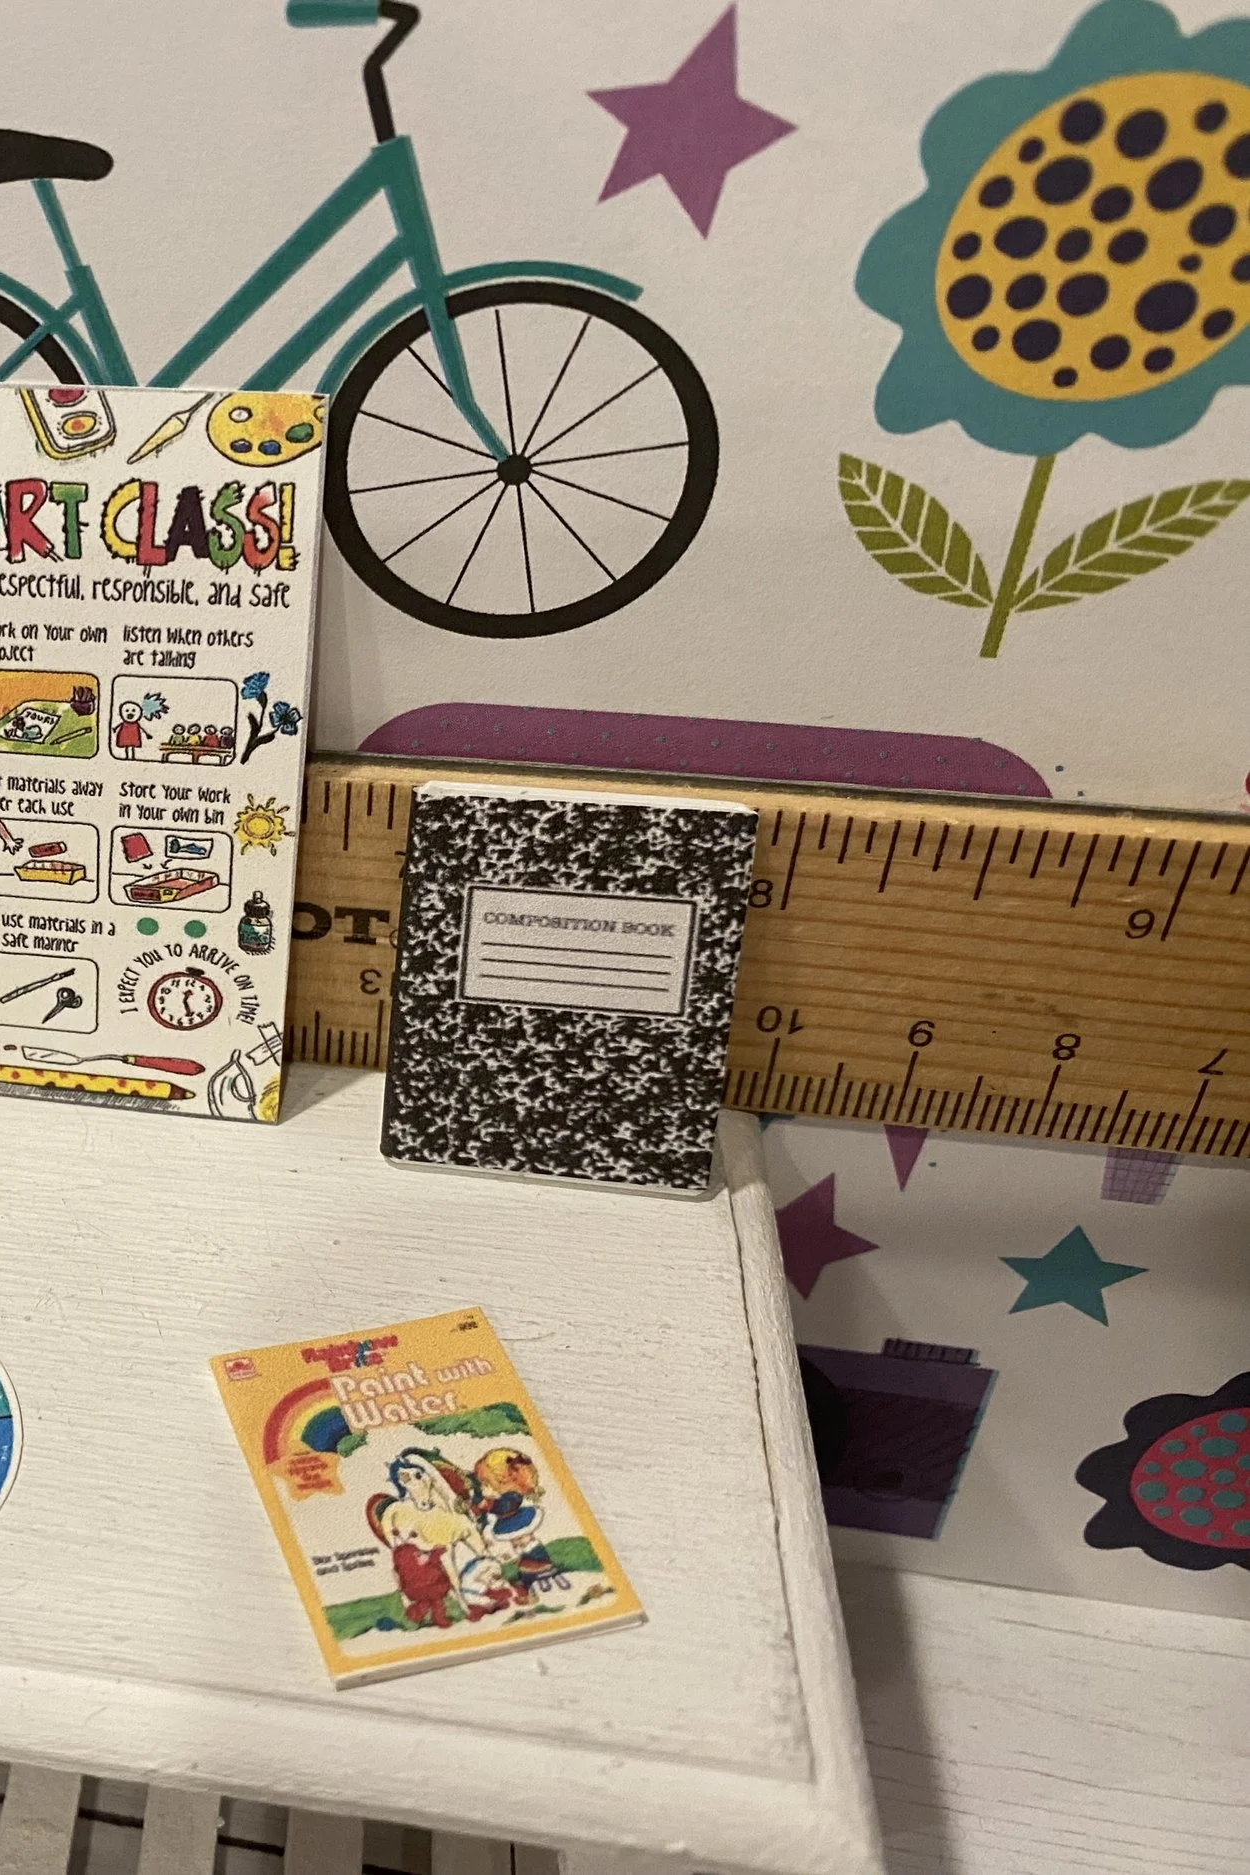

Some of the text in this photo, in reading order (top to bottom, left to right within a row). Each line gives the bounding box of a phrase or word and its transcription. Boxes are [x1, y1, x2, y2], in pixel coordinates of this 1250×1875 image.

[100, 477, 300, 576] CLASS!
[92, 578, 199, 607] responsible,
[208, 581, 242, 608] and
[248, 582, 290, 608] safe
[21, 623, 38, 640] on
[43, 624, 74, 641] your
[79, 625, 107, 643] own
[123, 624, 253, 648] listen when others
[123, 649, 197, 669] are talking
[7, 776, 66, 794] materials
[71, 780, 103, 797] away
[119, 781, 231, 804] store your work
[17, 798, 46, 814] each
[51, 800, 74, 816] use
[119, 803, 225, 825] in your own bin
[749, 879, 775, 908] 8
[1, 914, 115, 936] use materials in a
[484, 911, 677, 937] COMPOSITION BOOK
[1124, 908, 1156, 939] 9
[1, 932, 79, 953] safe manner
[117, 943, 261, 1025] I EXPECT YOU TO ARRIVE ON TIME!
[756, 1005, 805, 1036] 10
[1051, 1032, 1082, 1061] 8
[1197, 1048, 1228, 1076] 7
[329, 1356, 494, 1404] Paint with
[343, 1390, 458, 1430] Water
